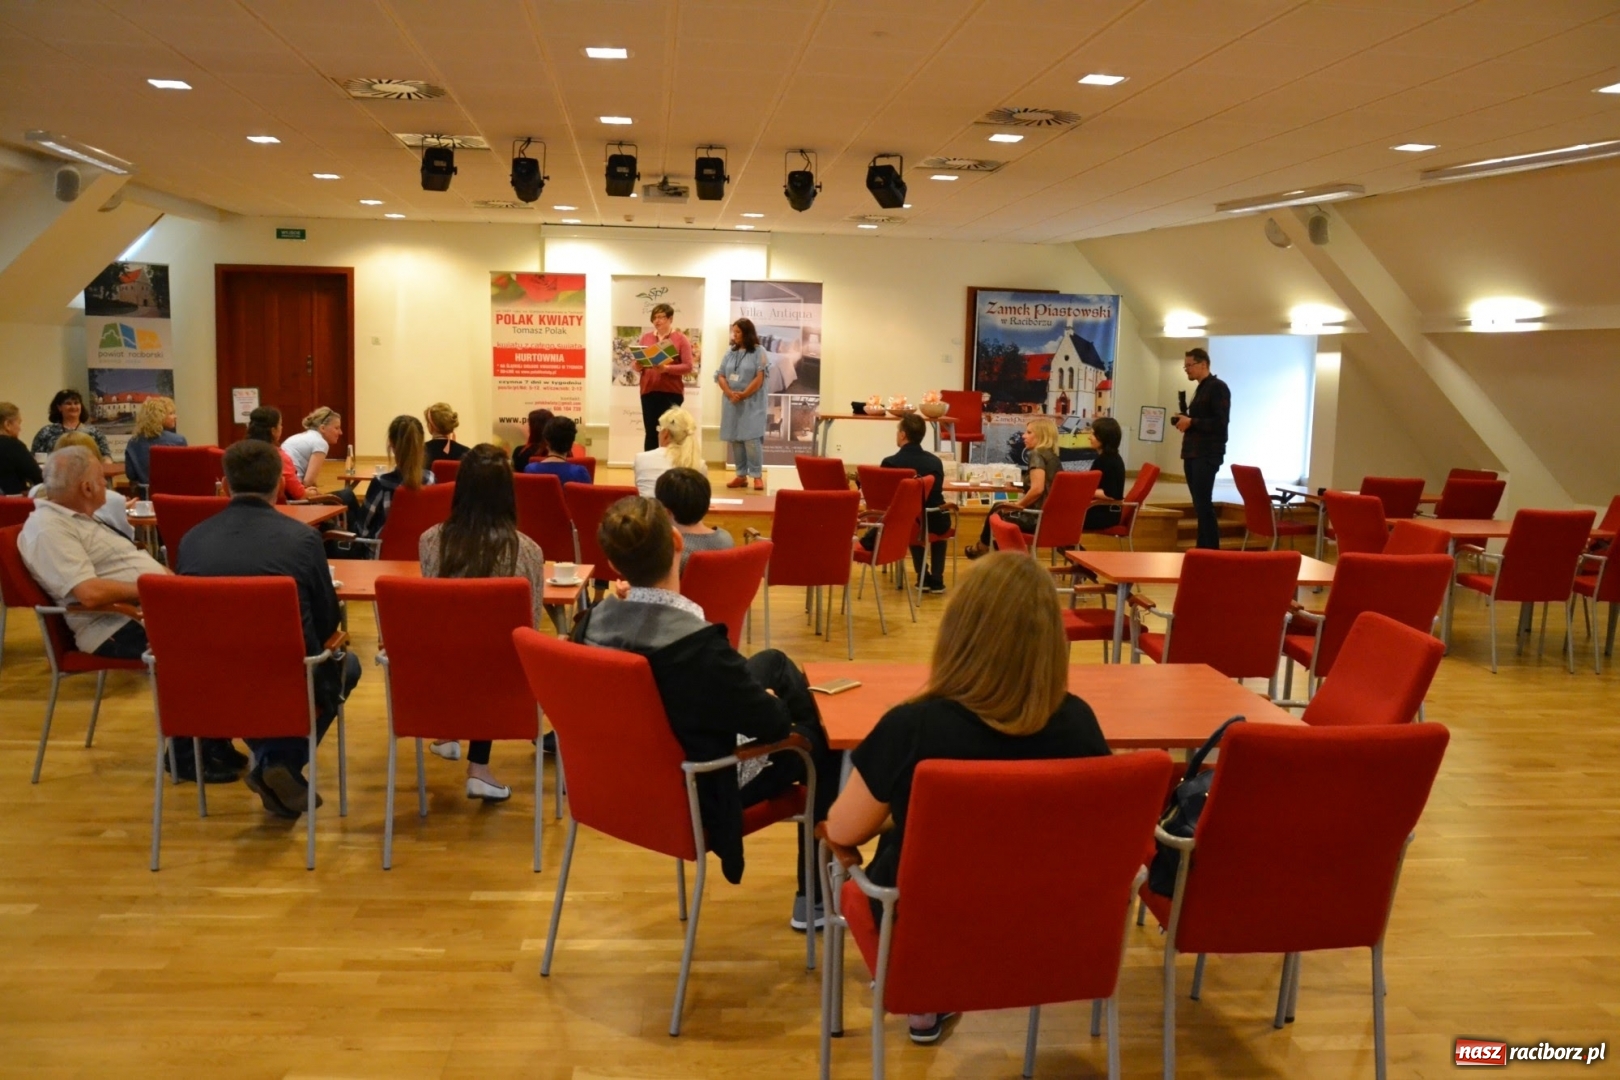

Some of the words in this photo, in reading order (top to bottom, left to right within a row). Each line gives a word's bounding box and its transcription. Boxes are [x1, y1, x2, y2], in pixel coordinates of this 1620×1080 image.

[740, 306, 763, 317] Villa
[769, 308, 813, 320] Antiqua
[986, 301, 1030, 316] Zamek
[1034, 303, 1111, 319] Piastowski
[496, 314, 534, 325] POLAK
[538, 314, 584, 326] KWIATY
[1010, 317, 1052, 327] Raciborzu
[512, 326, 542, 334] Tomasz
[545, 326, 567, 335] Polak
[98, 351, 124, 359] powiat
[514, 353, 565, 362] HURTOWNIA
